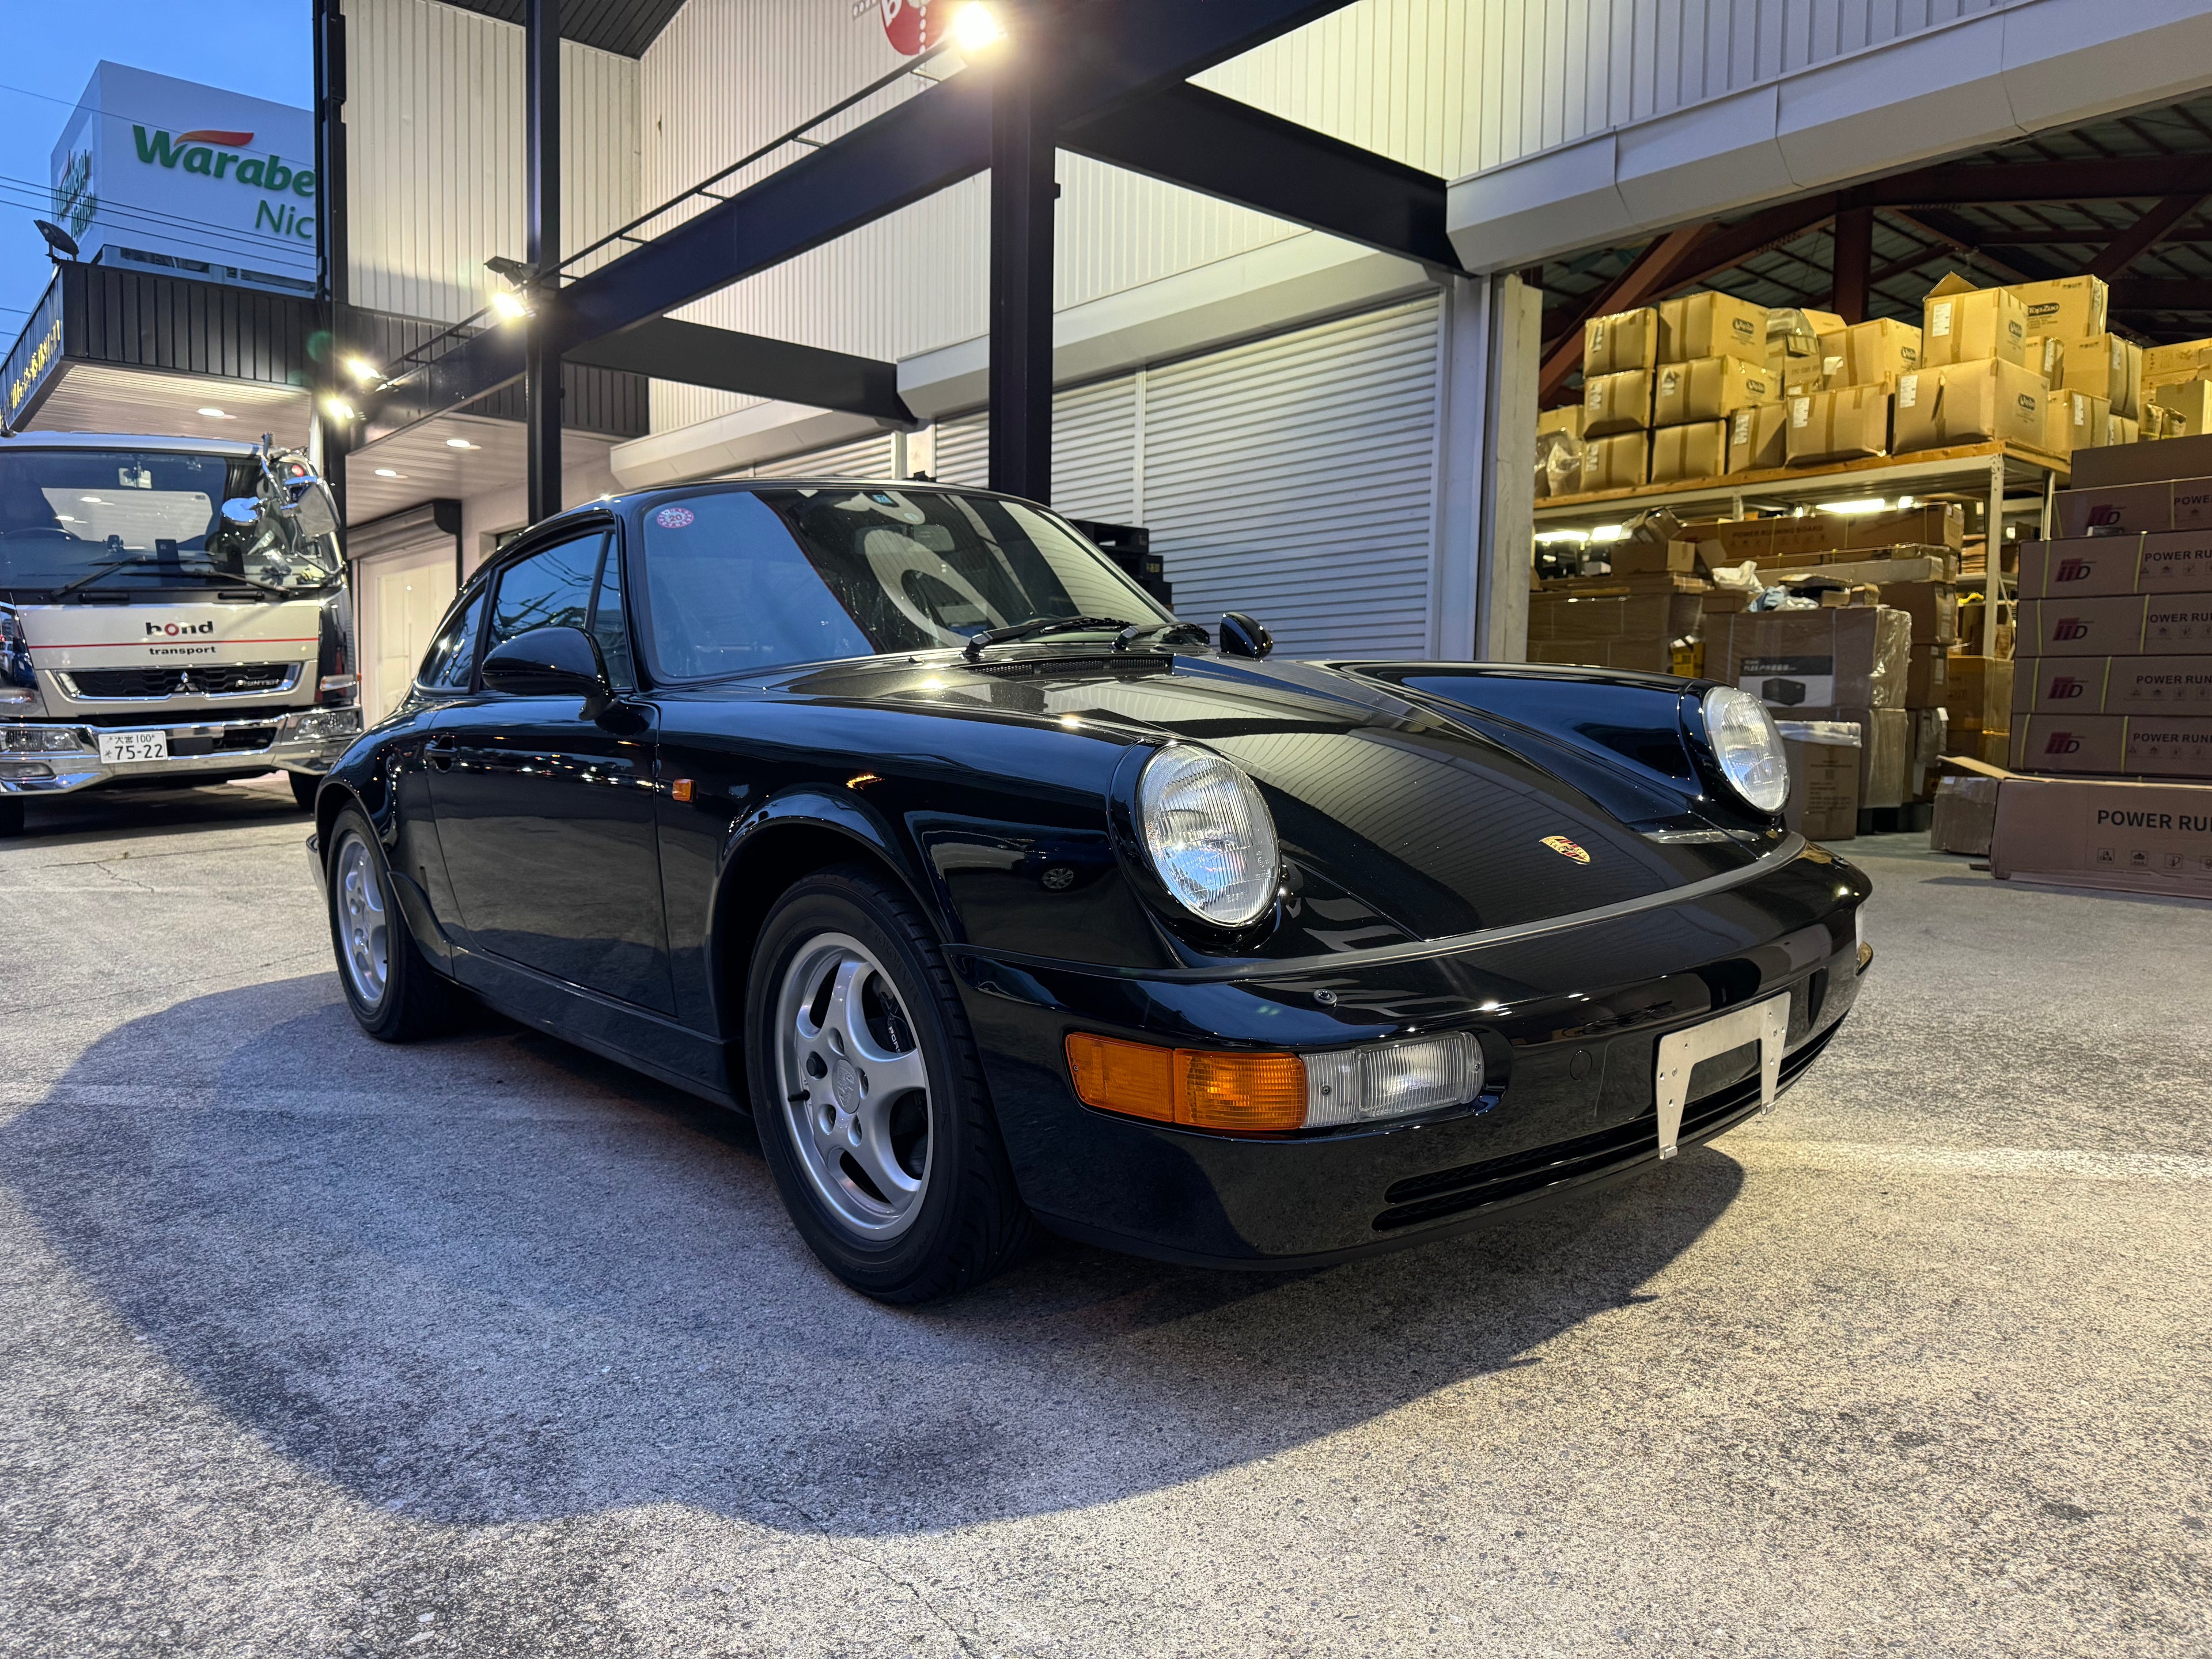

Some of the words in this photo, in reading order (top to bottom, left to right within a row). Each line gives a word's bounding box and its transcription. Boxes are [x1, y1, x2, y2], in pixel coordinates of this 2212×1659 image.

[132, 124, 315, 197] Warabe
[255, 200, 315, 238] Nic
[2145, 551, 2191, 562] POWER
[2192, 612, 2212, 622] RU
[145, 620, 214, 637] bond
[149, 646, 216, 655] transport
[2137, 675, 2182, 684] POWER
[136, 734, 151, 743] 100
[2133, 733, 2179, 742] POWER
[115, 744, 164, 760] 75-22
[2097, 809, 2172, 830] POWER
[2179, 815, 2212, 831] RU
